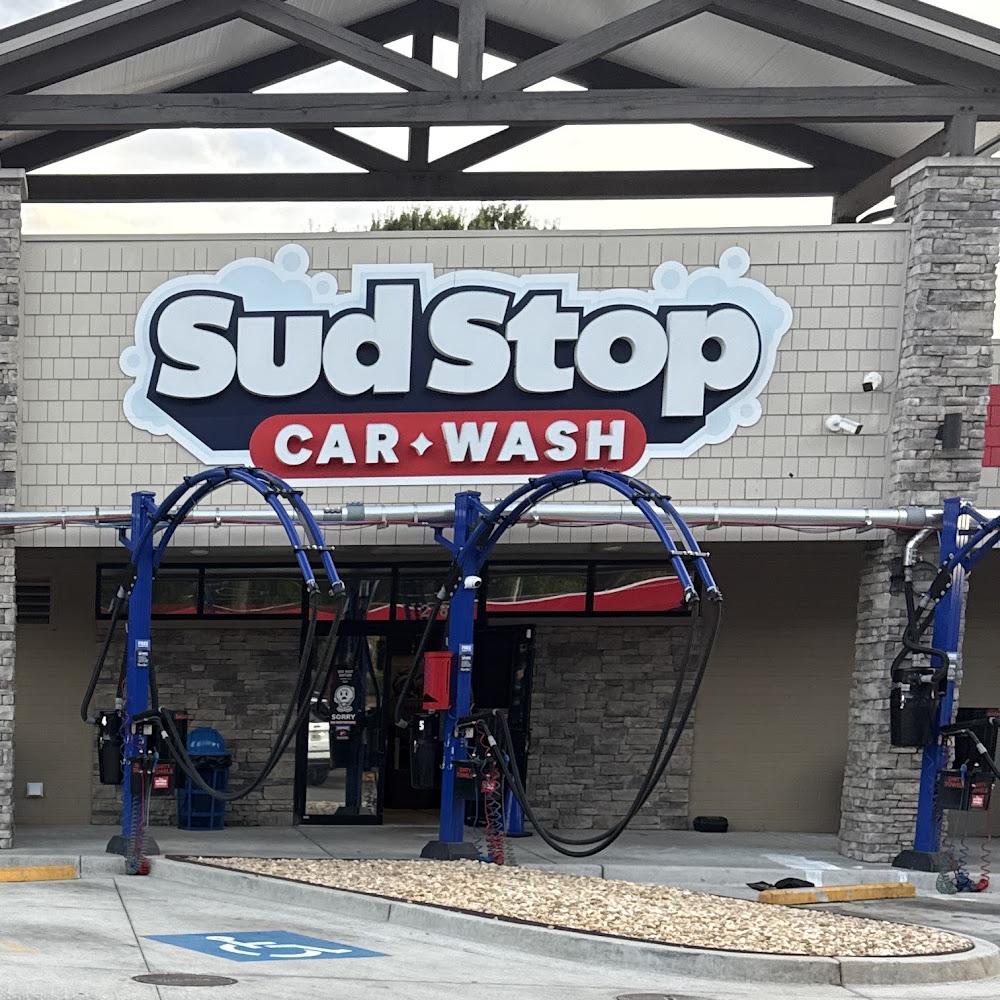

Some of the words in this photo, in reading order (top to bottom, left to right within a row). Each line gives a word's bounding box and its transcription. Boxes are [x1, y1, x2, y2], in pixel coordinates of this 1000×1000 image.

[273, 422, 400, 467] CAR
[440, 418, 627, 463] WASH
[418, 719, 425, 731] 5
